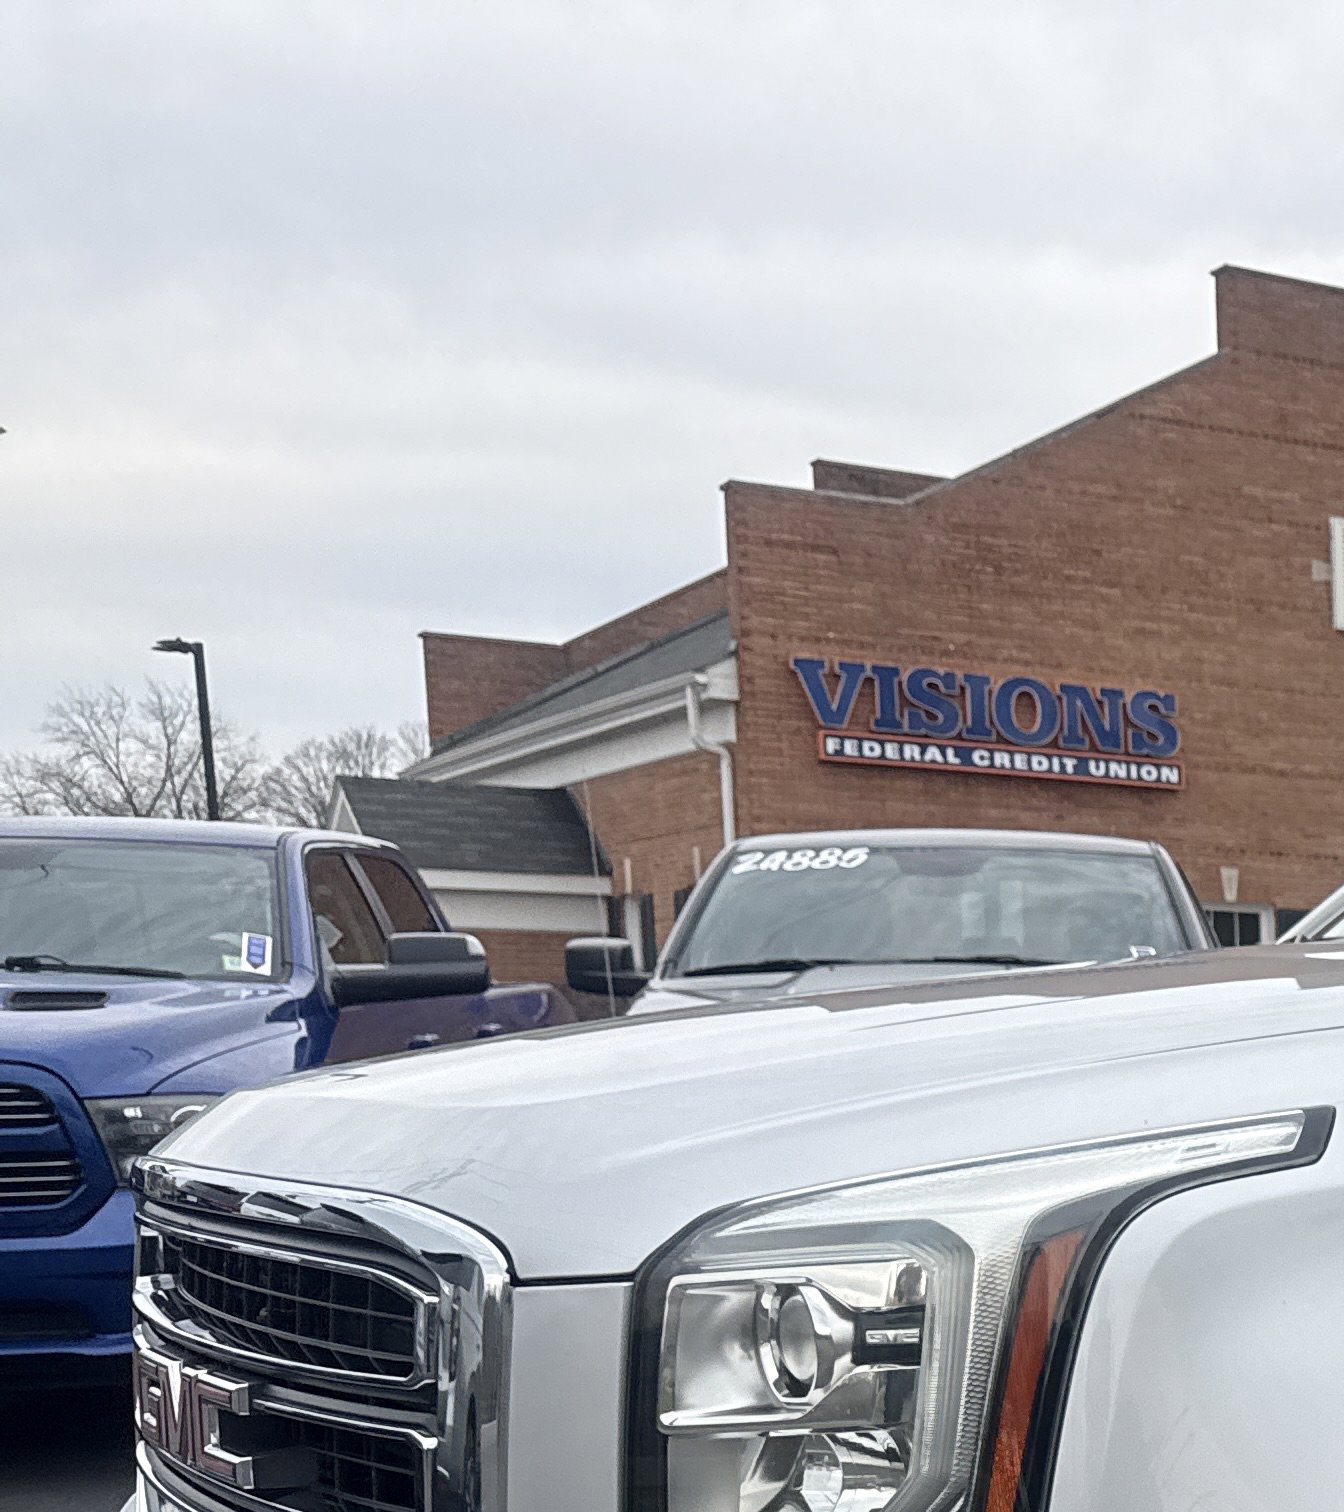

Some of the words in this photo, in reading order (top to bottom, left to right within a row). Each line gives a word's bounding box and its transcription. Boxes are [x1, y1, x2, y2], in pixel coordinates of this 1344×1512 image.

[789, 655, 1180, 758] VISIONS
[824, 735, 961, 765] FEDERAL
[971, 748, 1078, 775] CREDIT
[1088, 758, 1180, 784] UNION
[133, 1348, 254, 1490] GMC
